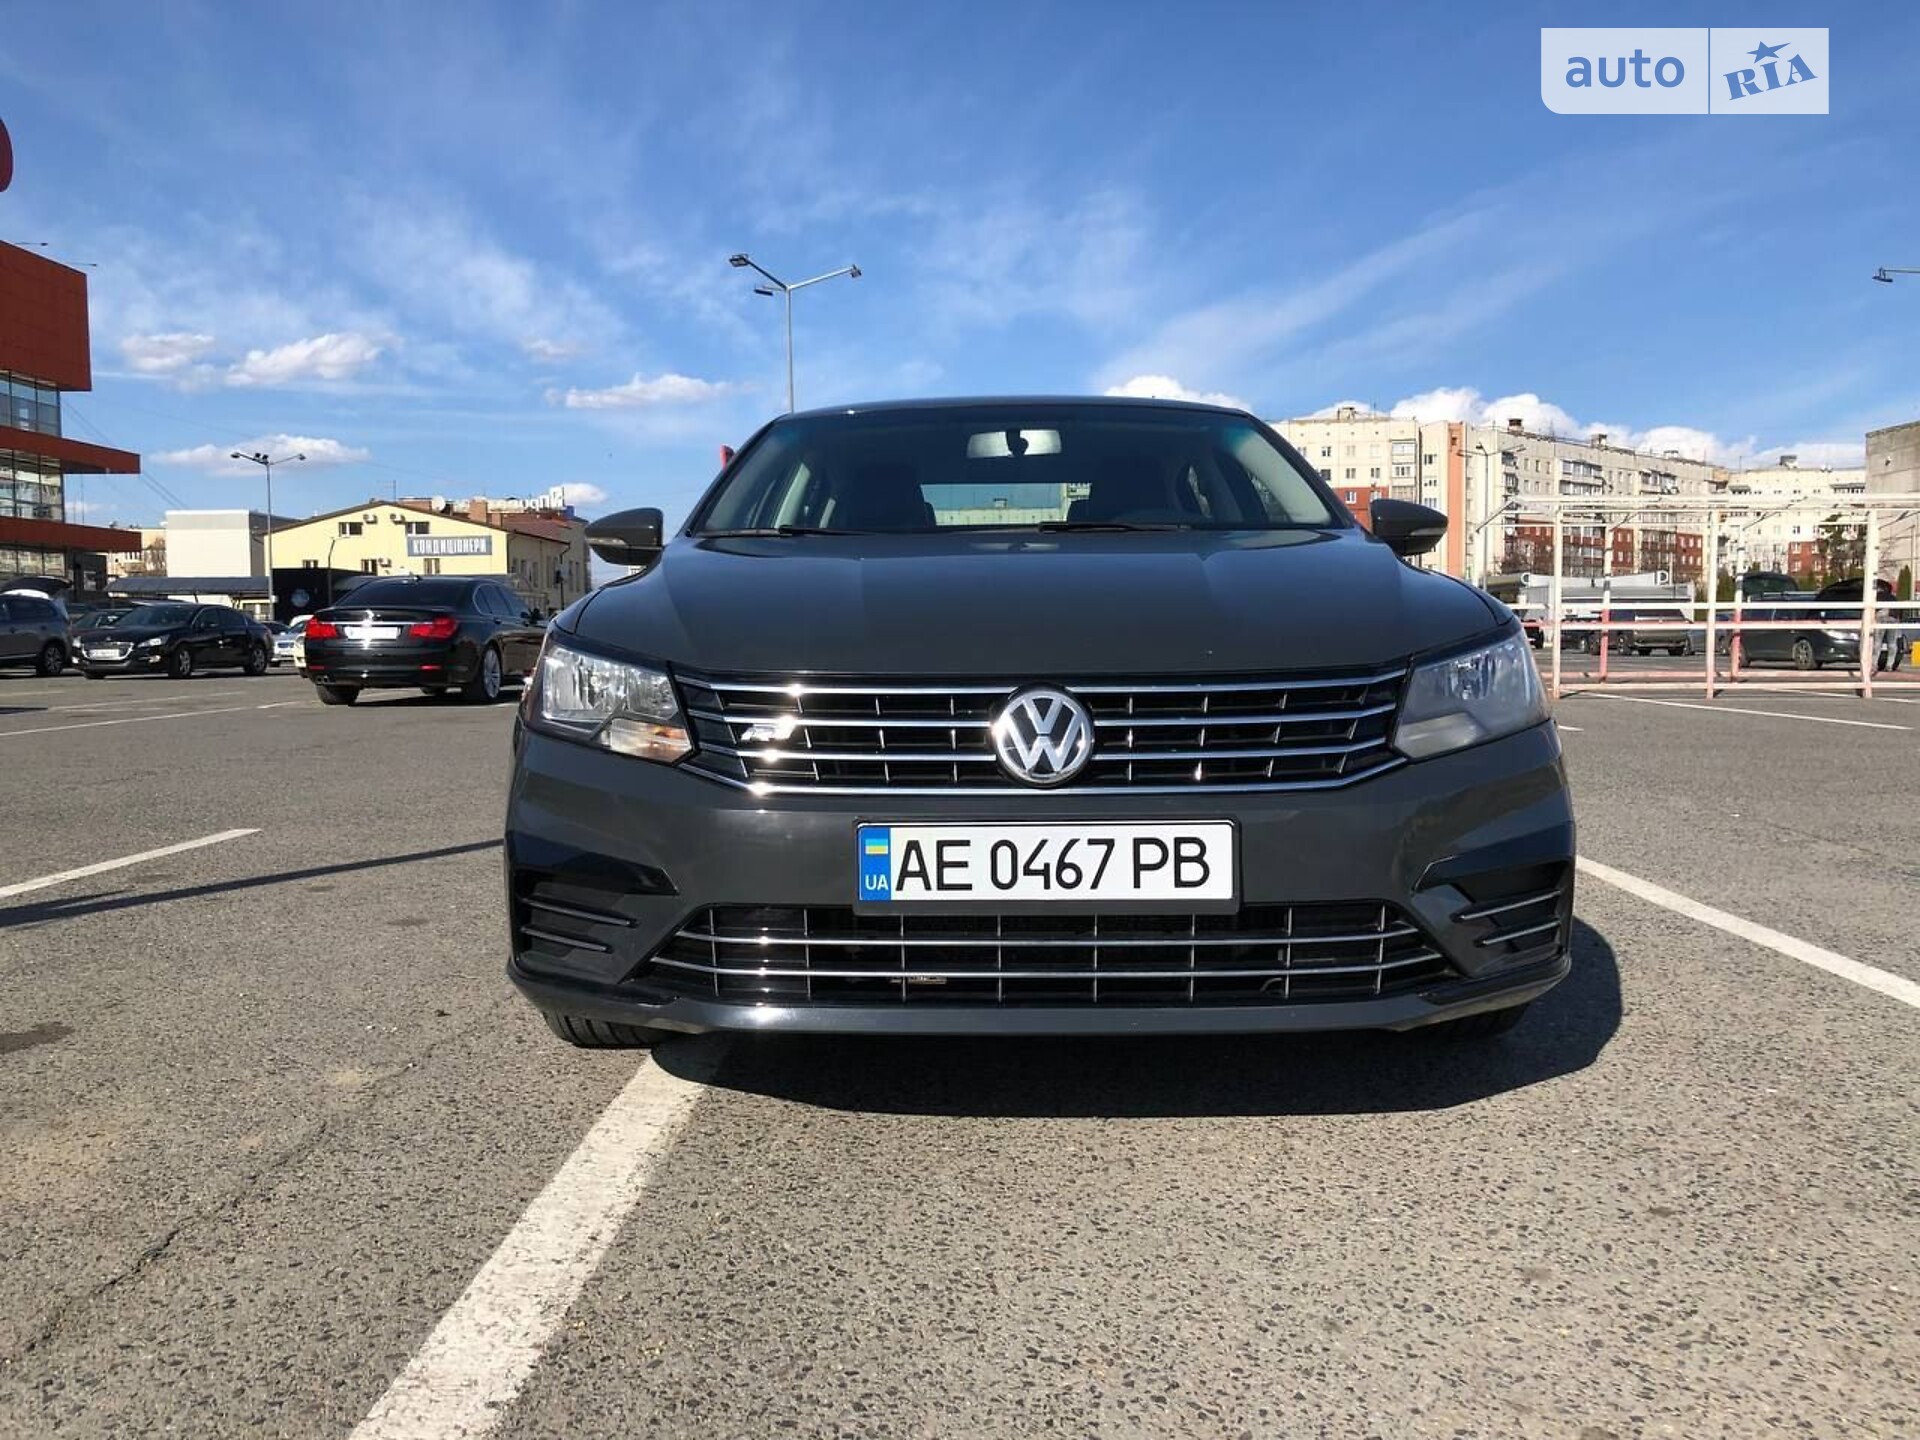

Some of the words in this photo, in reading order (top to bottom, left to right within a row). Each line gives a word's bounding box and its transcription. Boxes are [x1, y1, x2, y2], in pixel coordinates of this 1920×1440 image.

[895, 839, 973, 891] AE
[990, 838, 1116, 891] 0467
[1132, 836, 1211, 889] PB
[865, 874, 889, 891] UA
